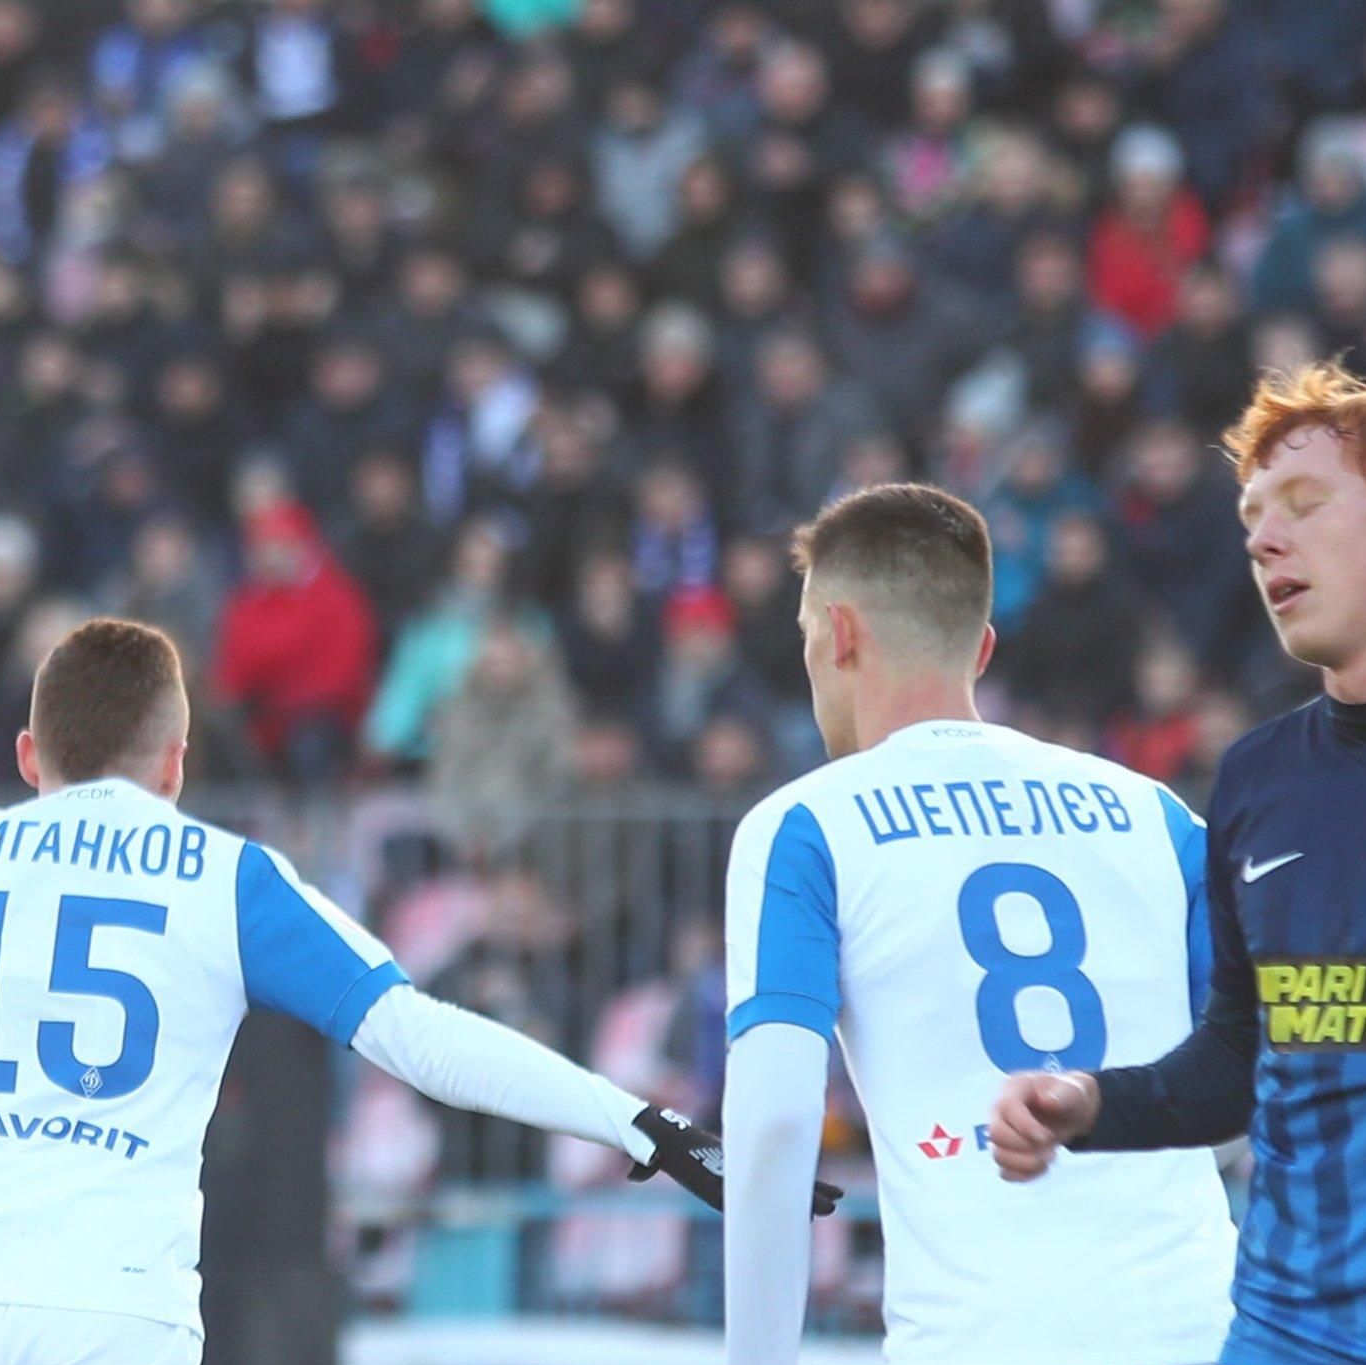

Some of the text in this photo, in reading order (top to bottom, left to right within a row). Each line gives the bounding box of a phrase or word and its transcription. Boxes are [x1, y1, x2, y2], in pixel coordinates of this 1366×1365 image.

[66, 787, 116, 800] FCDK
[853, 779, 1132, 846] ШЕПЕЛЄВ
[957, 862, 1107, 1074] 8
